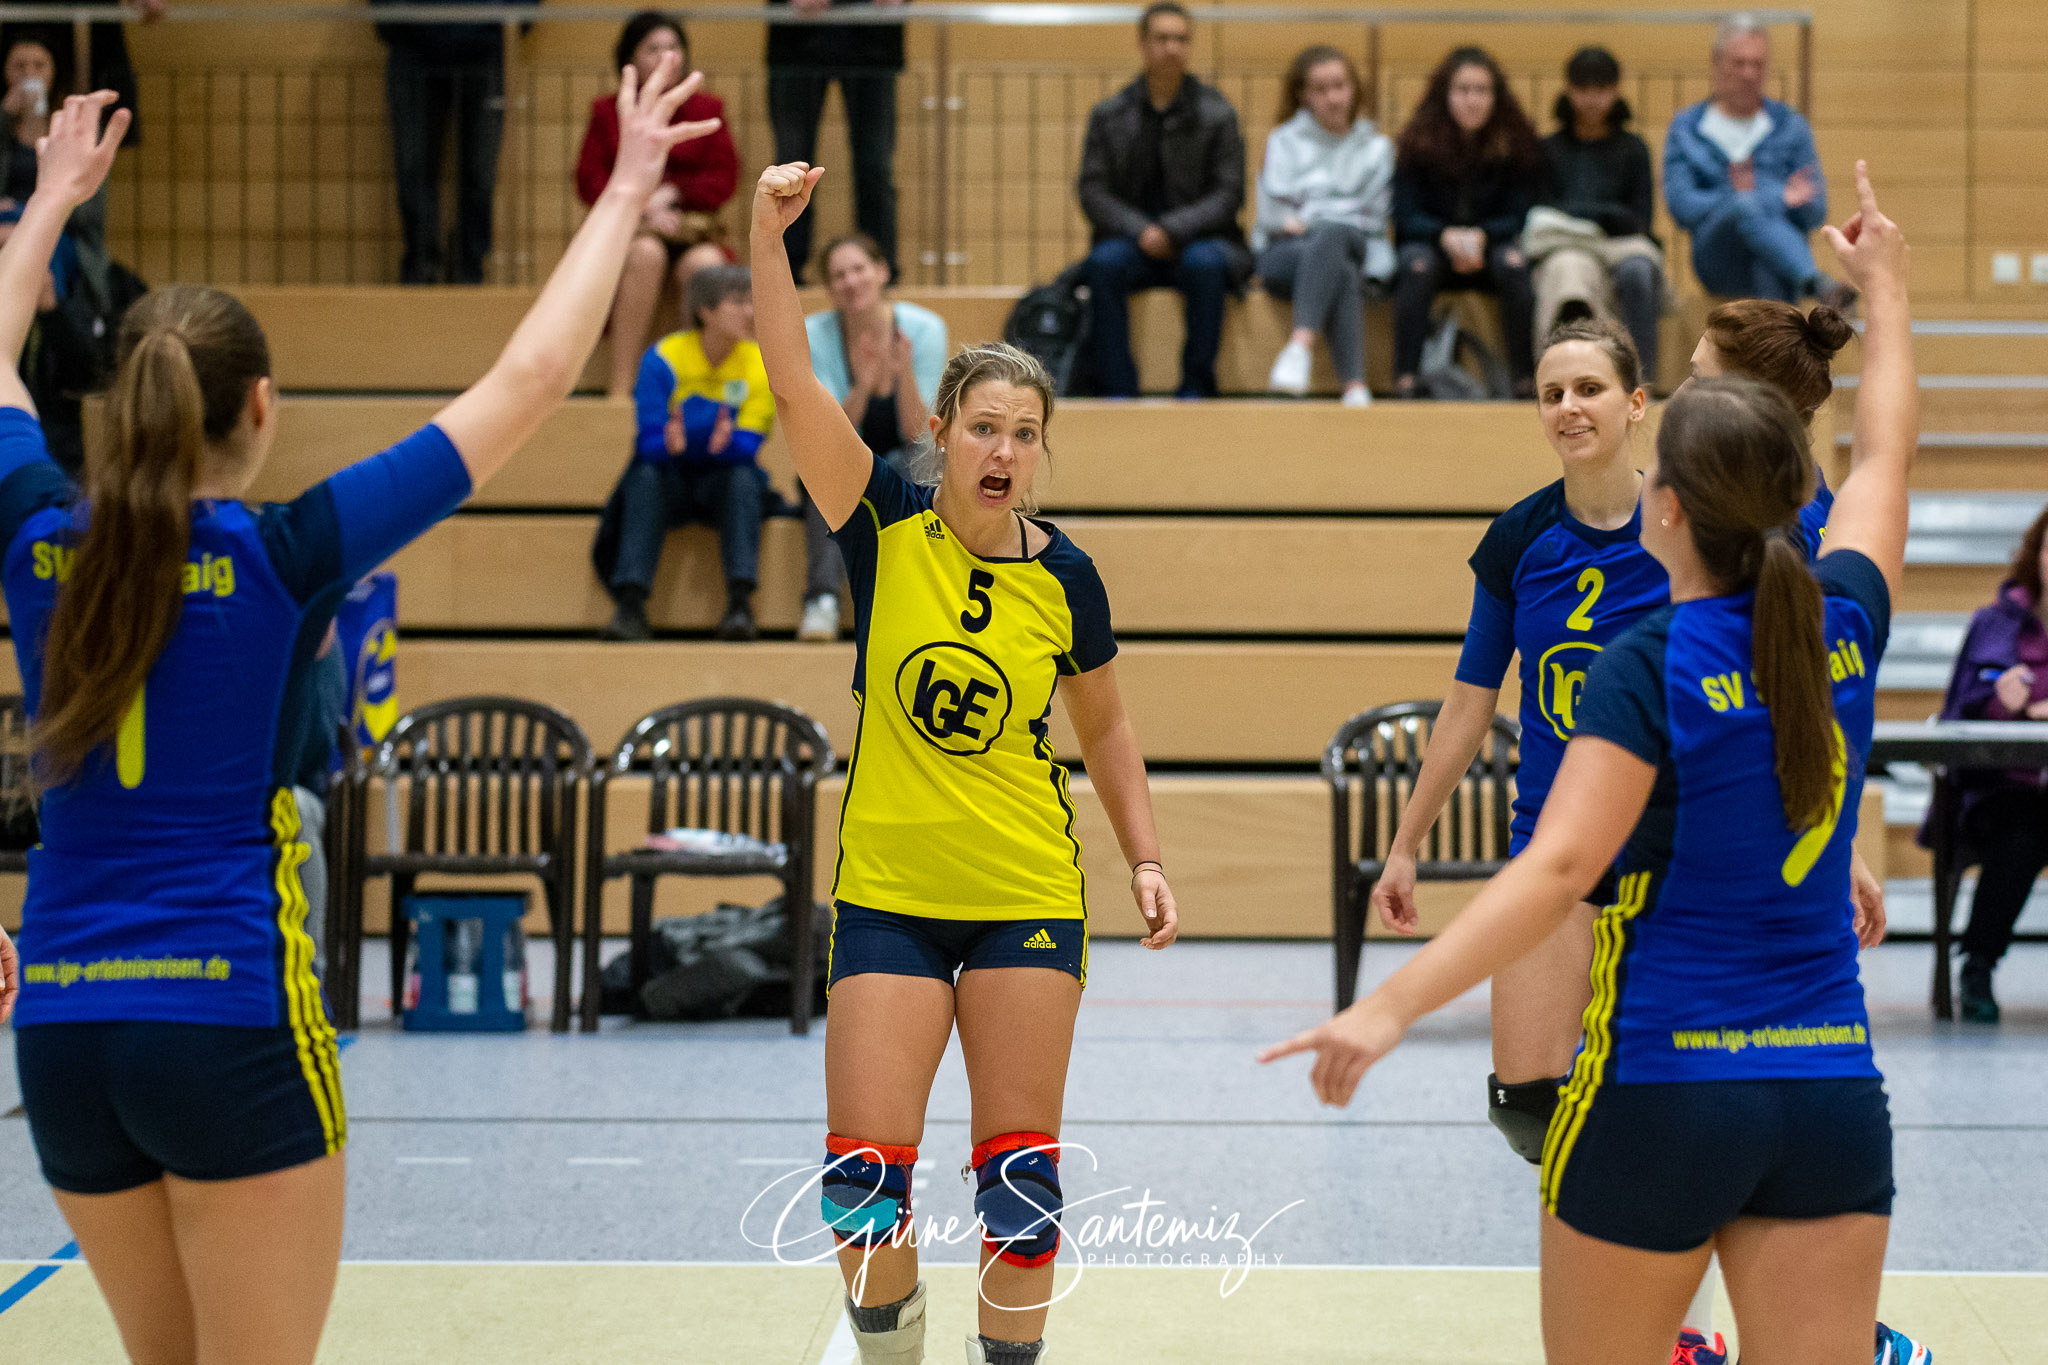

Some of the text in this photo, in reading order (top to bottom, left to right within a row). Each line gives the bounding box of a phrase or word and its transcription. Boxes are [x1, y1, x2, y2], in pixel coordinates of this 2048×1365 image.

[32, 541, 75, 583] SV
[960, 568, 994, 633] 5
[1566, 567, 1605, 632] 2
[912, 658, 999, 741] IGE
[1701, 670, 1745, 713] SV
[1023, 940, 1057, 949] adidas
